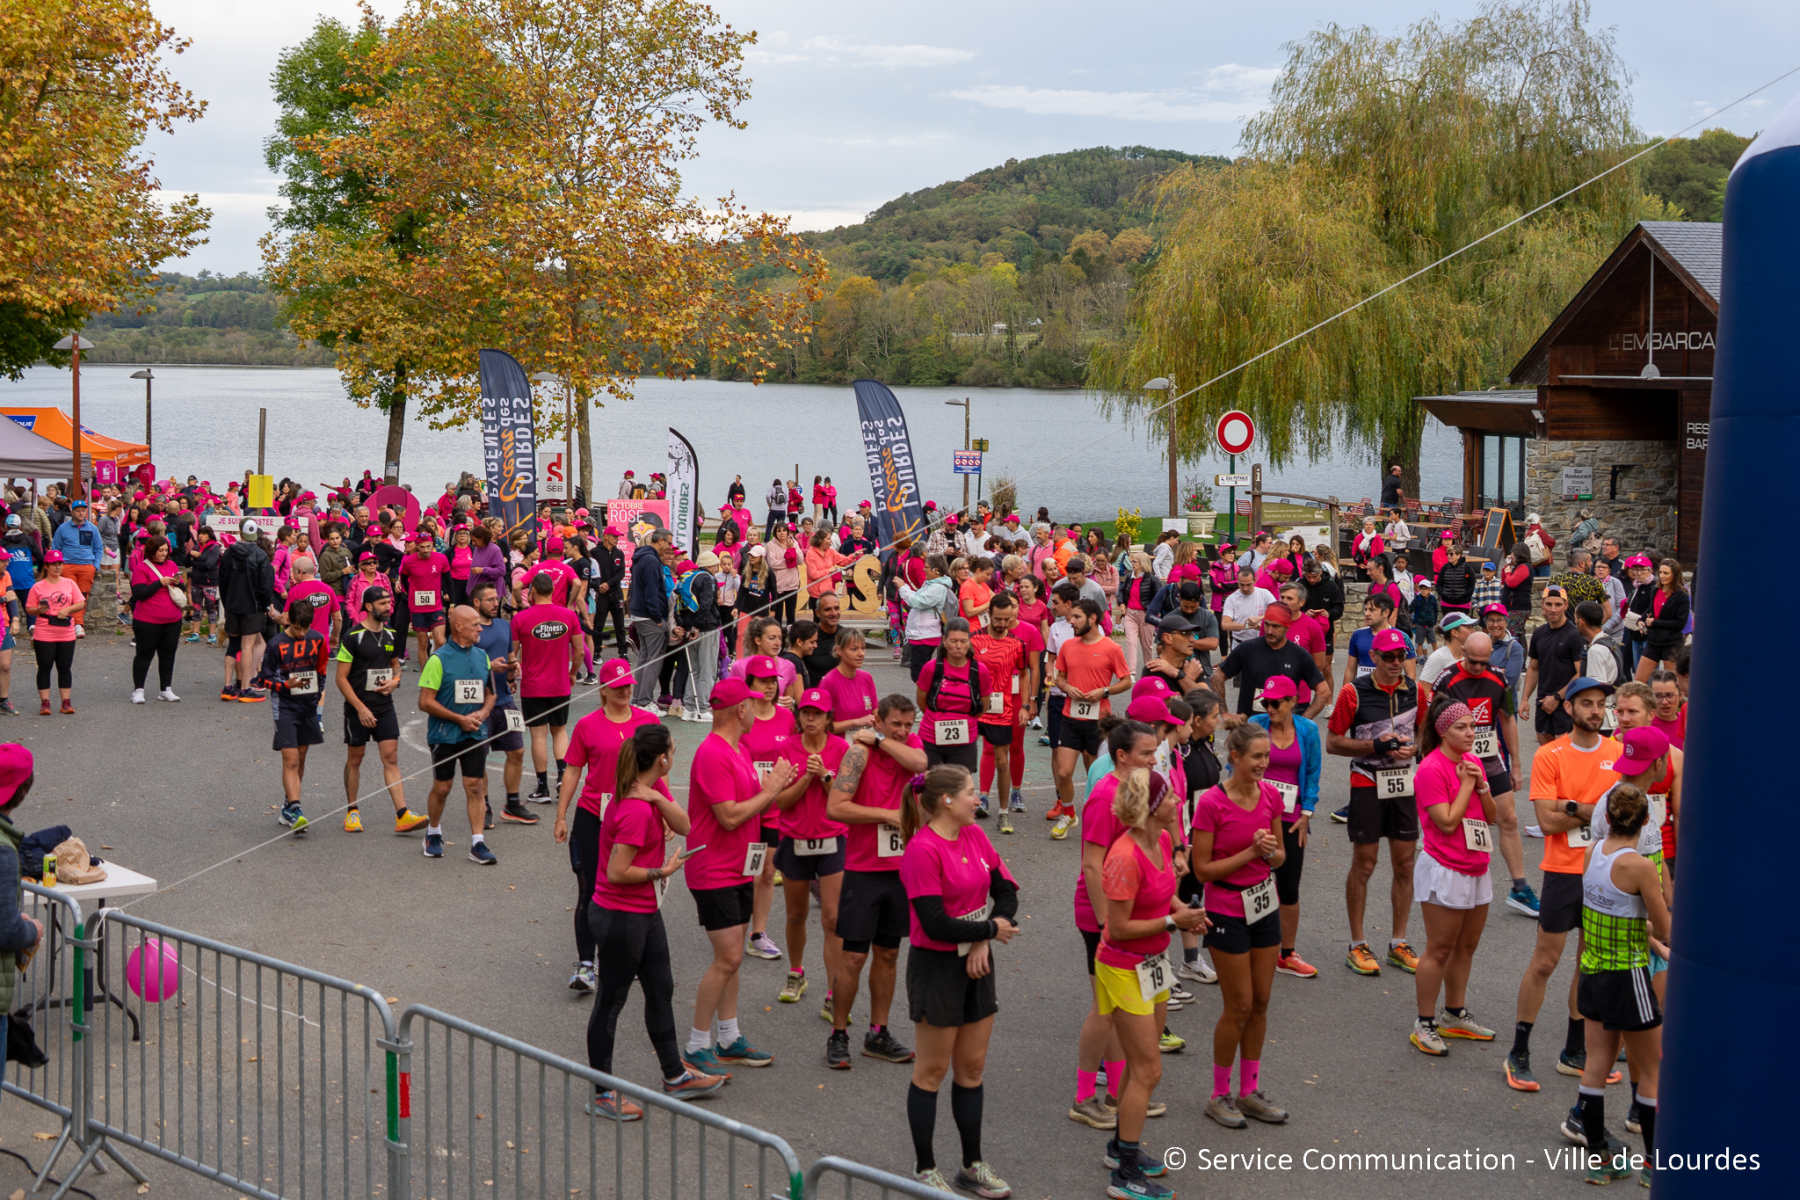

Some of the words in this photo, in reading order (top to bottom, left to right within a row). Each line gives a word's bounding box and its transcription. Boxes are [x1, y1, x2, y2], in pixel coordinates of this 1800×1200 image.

[546, 485, 564, 493] SEB
[609, 501, 645, 510] OCTOBRE
[610, 509, 645, 523] ROSE
[420, 595, 431, 604] 50
[278, 639, 322, 661] FOX
[463, 687, 477, 700] 52
[1078, 703, 1091, 716] 37
[512, 716, 520, 728] 12
[1475, 725, 1492, 733] AISSE
[944, 727, 960, 741] 23
[1474, 740, 1490, 754] 32
[1387, 777, 1405, 794] 55
[1473, 828, 1487, 847] 51
[1253, 890, 1271, 915] 35
[1149, 966, 1164, 990] 19
